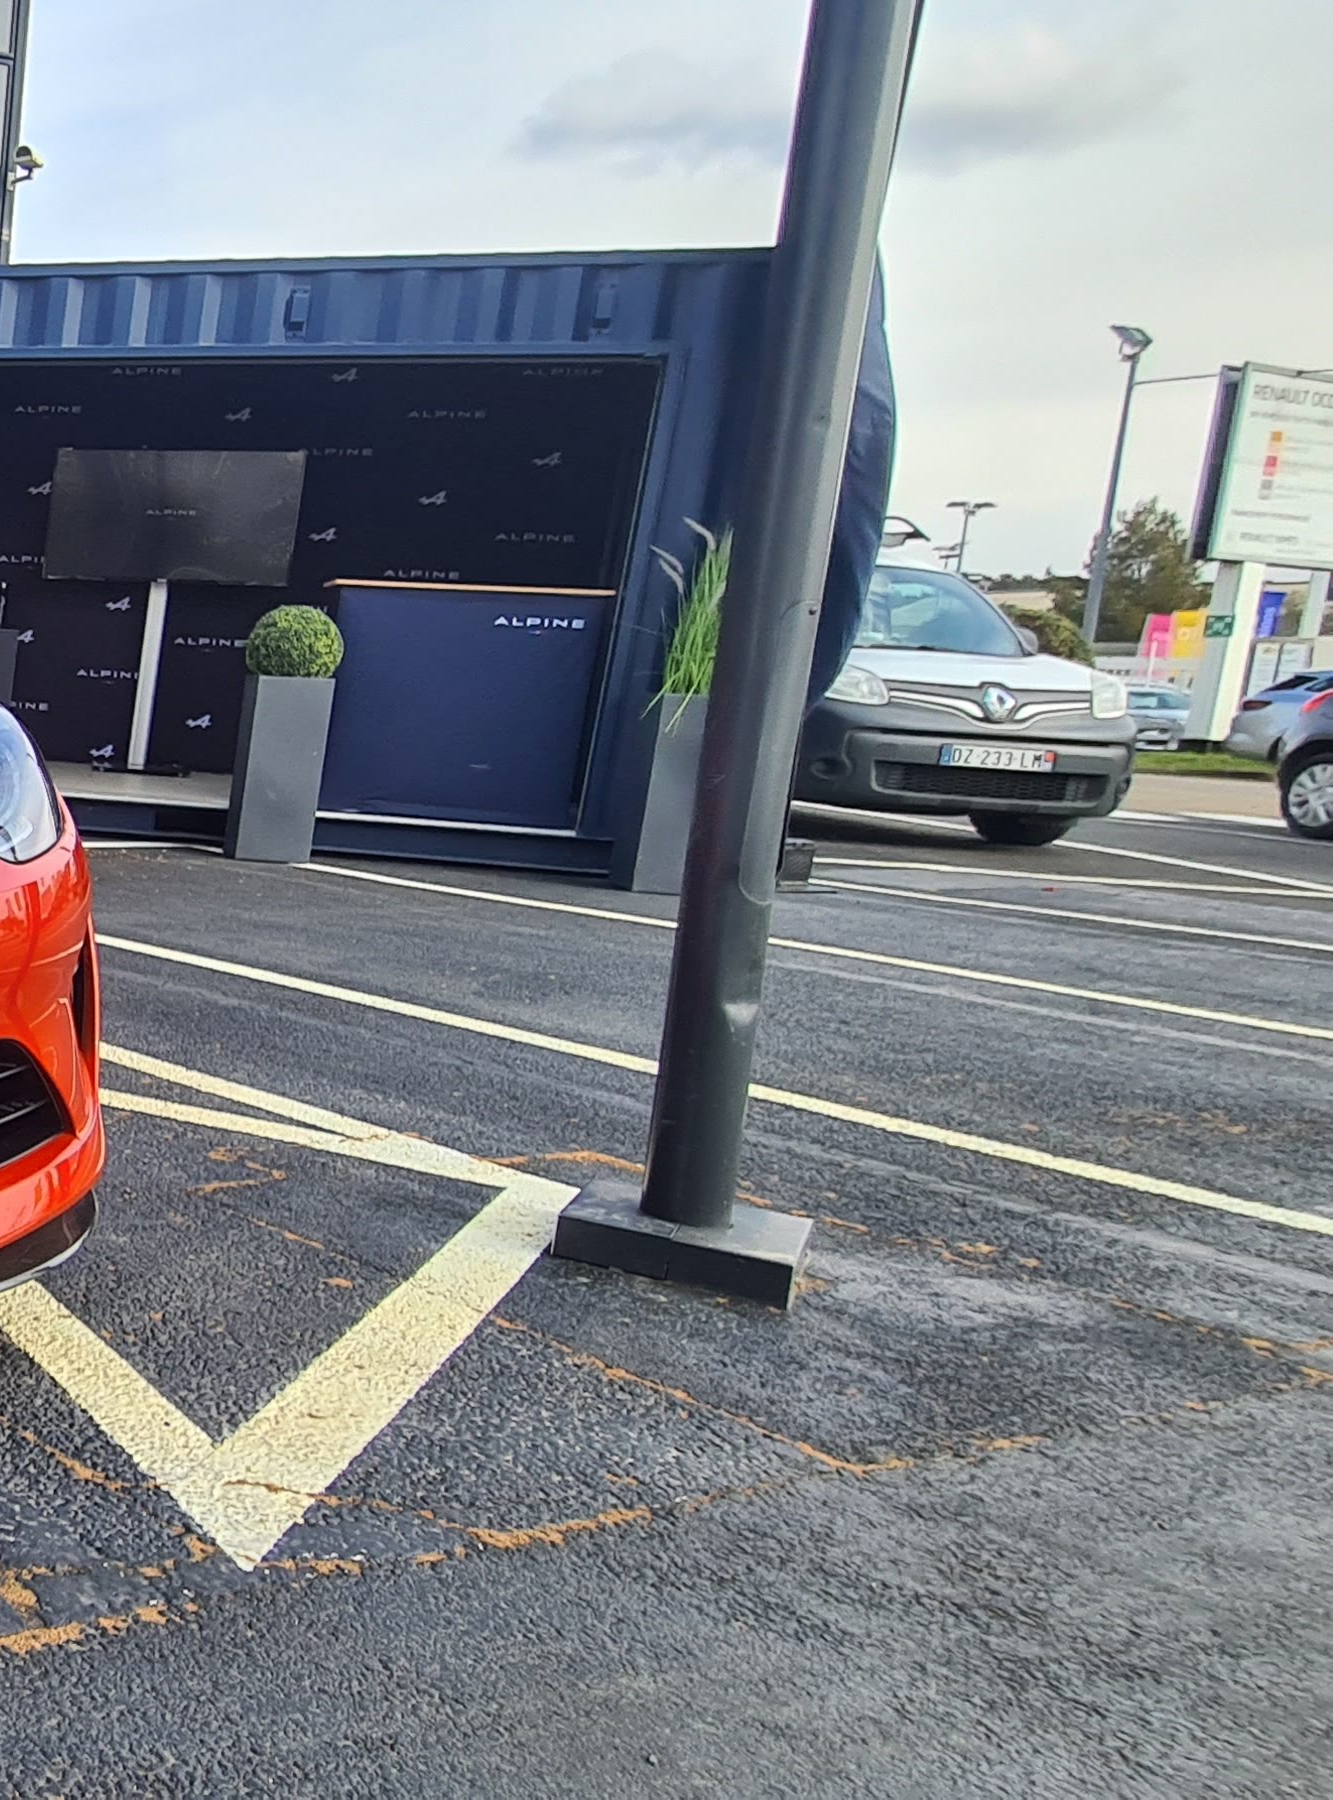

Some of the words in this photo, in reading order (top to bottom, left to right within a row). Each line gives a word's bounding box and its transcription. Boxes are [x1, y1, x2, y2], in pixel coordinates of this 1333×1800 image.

[112, 366, 182, 376] ALPINE
[14, 404, 83, 415] ALPINE
[312, 446, 373, 457] LPINE
[494, 532, 576, 543] ALPINE
[383, 567, 461, 579] ALPINE
[493, 614, 588, 630] ALPINE
[76, 668, 139, 680] ALPIN
